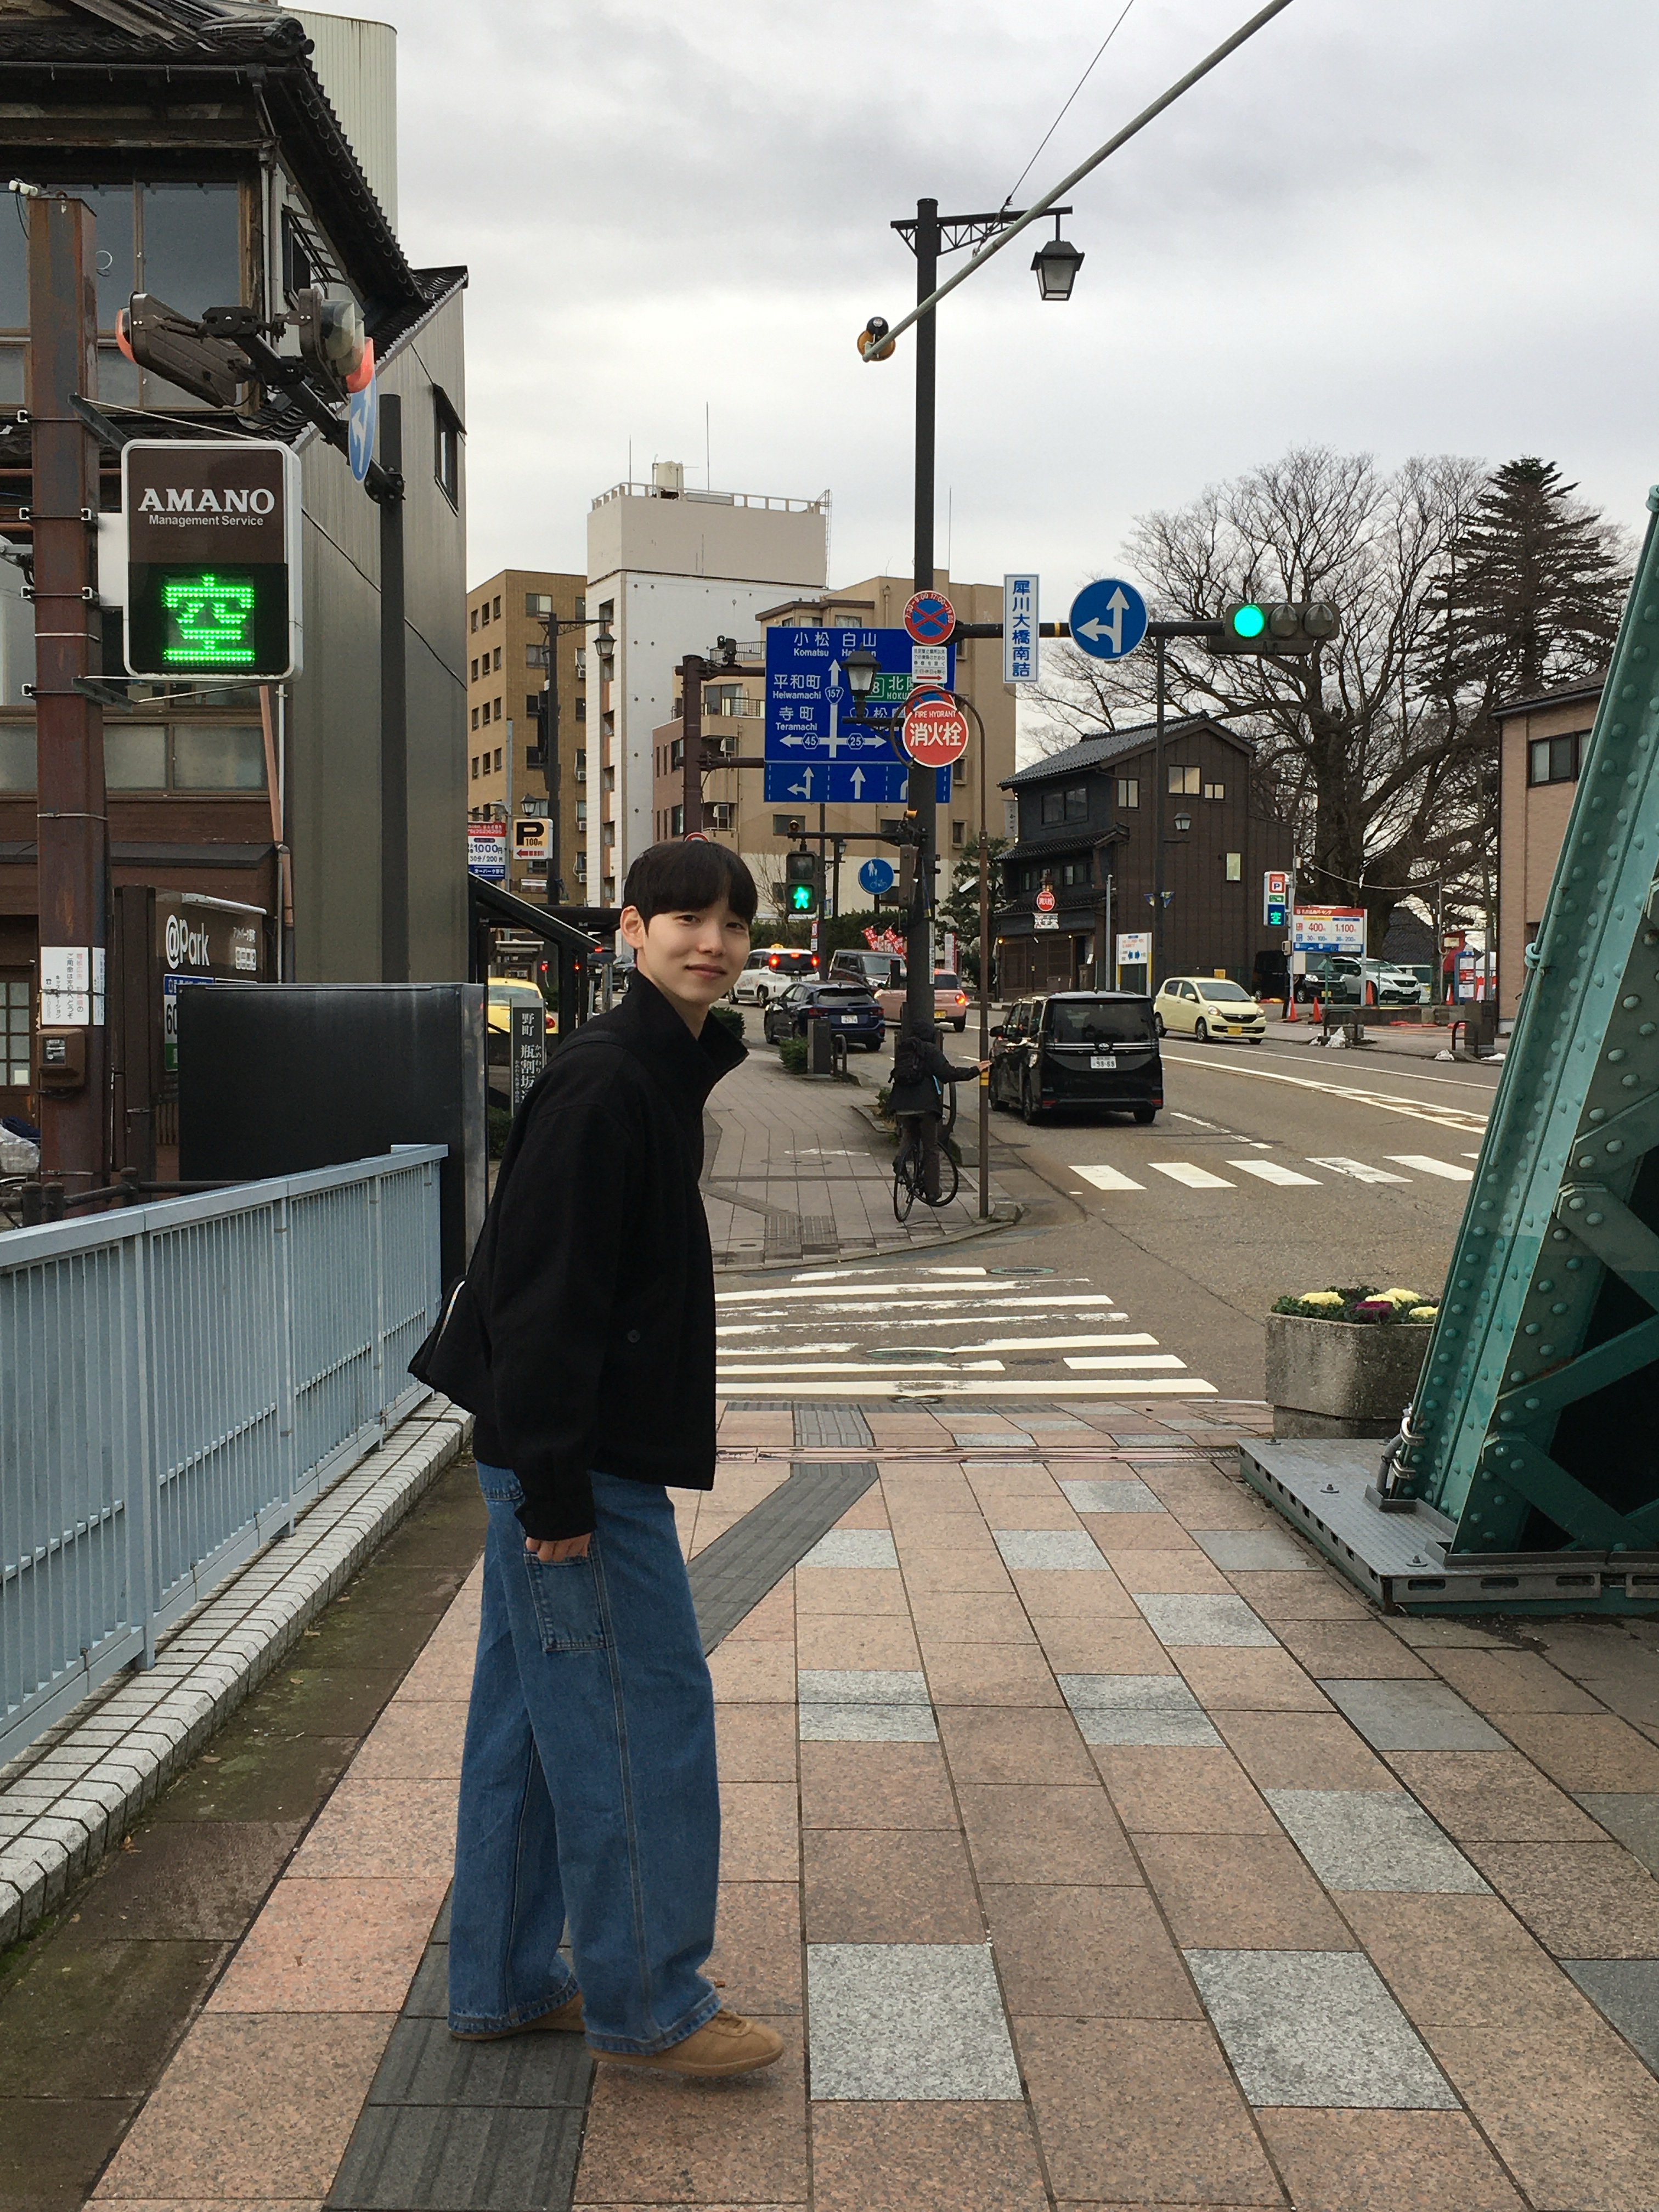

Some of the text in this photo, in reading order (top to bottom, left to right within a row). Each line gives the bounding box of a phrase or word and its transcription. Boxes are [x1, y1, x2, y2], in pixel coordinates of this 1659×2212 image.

[138, 488, 275, 513] AMANO
[149, 515, 264, 527] Management Service
[163, 573, 255, 662] 空
[1012, 580, 1030, 677] 犀川大橋南詰
[794, 632, 877, 647] 小松 白山
[794, 648, 829, 657] Komatsu
[774, 674, 821, 690] 平和町
[772, 691, 822, 699] Heiwamachi
[827, 689, 840, 698] 157
[779, 706, 814, 721] 寺町
[929, 710, 956, 718] HYDRANT
[775, 722, 817, 731] Teramachi
[910, 721, 963, 747] 消火栓
[804, 737, 816, 746] 45
[850, 737, 861, 746] 25
[516, 822, 545, 846] P
[526, 838, 543, 846] 100円
[166, 914, 210, 969] @Park
[522, 1013, 535, 1036] 野町
